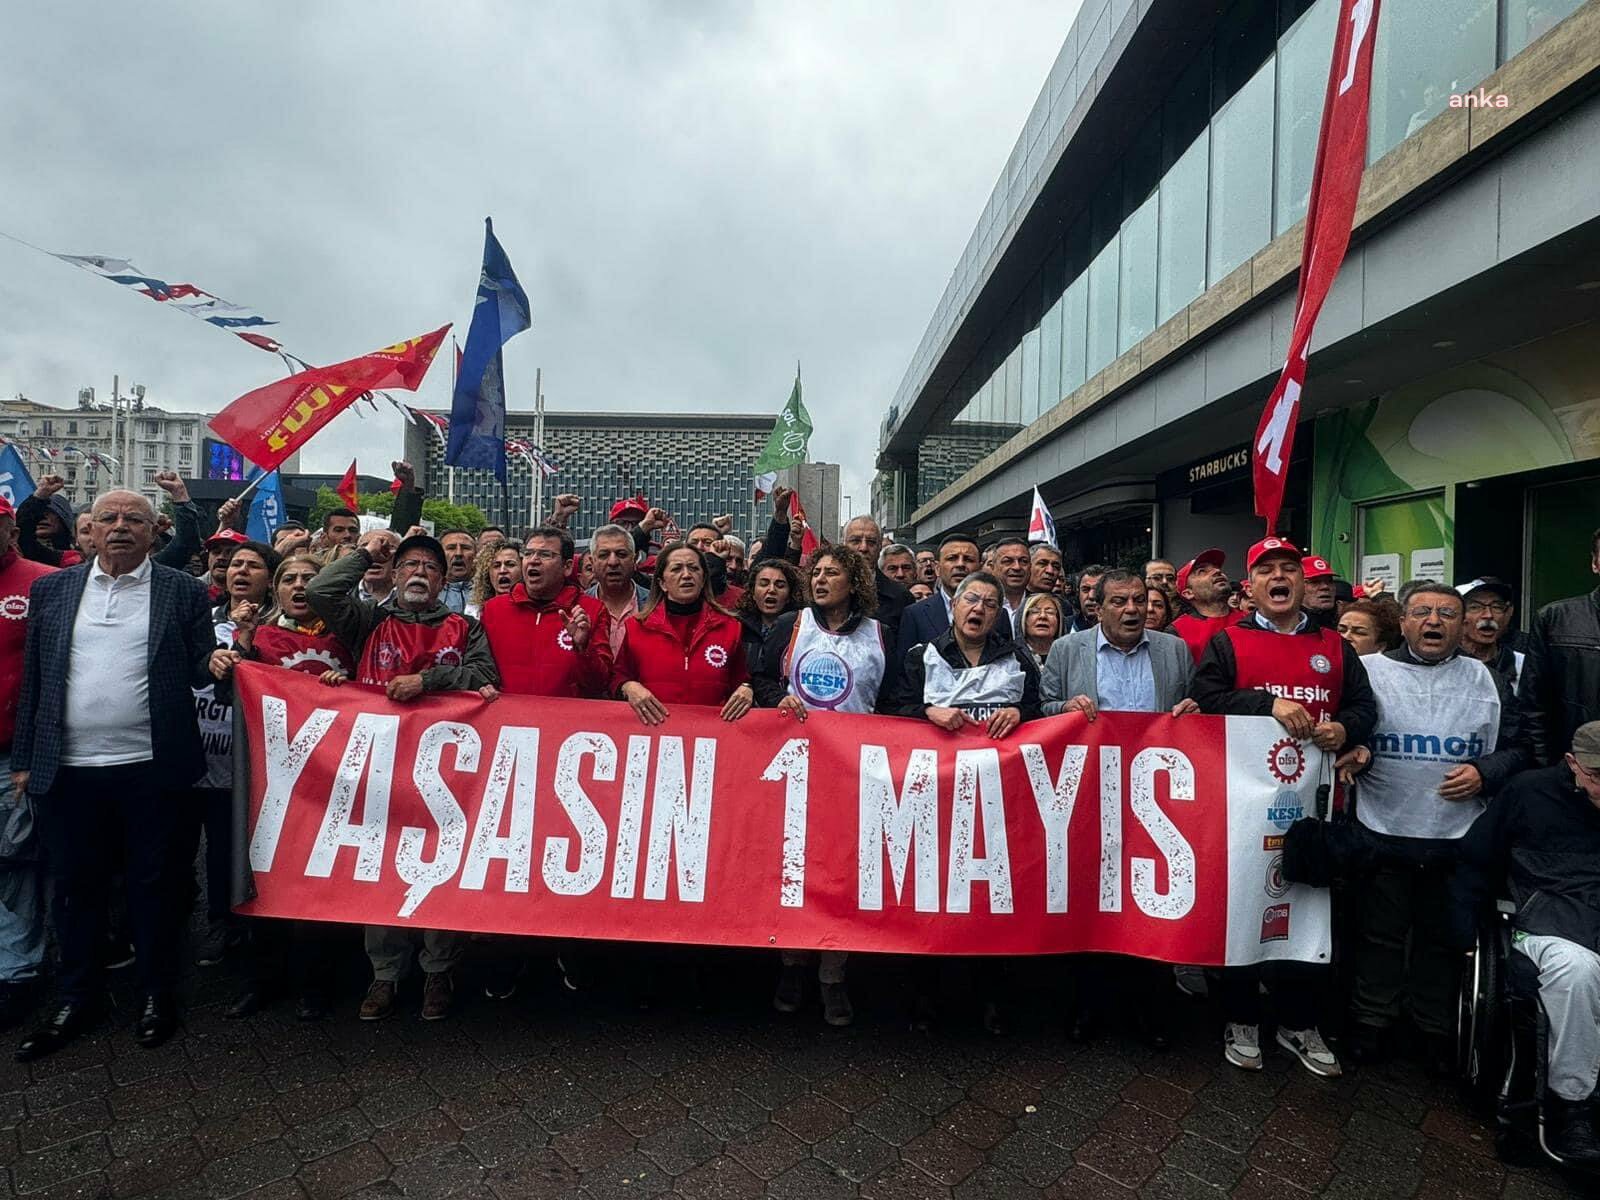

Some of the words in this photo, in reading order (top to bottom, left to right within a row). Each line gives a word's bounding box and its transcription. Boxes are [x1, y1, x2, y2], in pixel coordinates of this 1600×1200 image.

[1189, 449, 1248, 482] STARBUCKS
[801, 670, 847, 690] KESK
[1253, 683, 1331, 704] İRLEŞİK
[1278, 753, 1298, 766] DİSK
[249, 694, 718, 918] YAŞASIN
[760, 738, 809, 908] 1
[858, 743, 1195, 920] MAYIS
[1267, 807, 1304, 821] KESK
